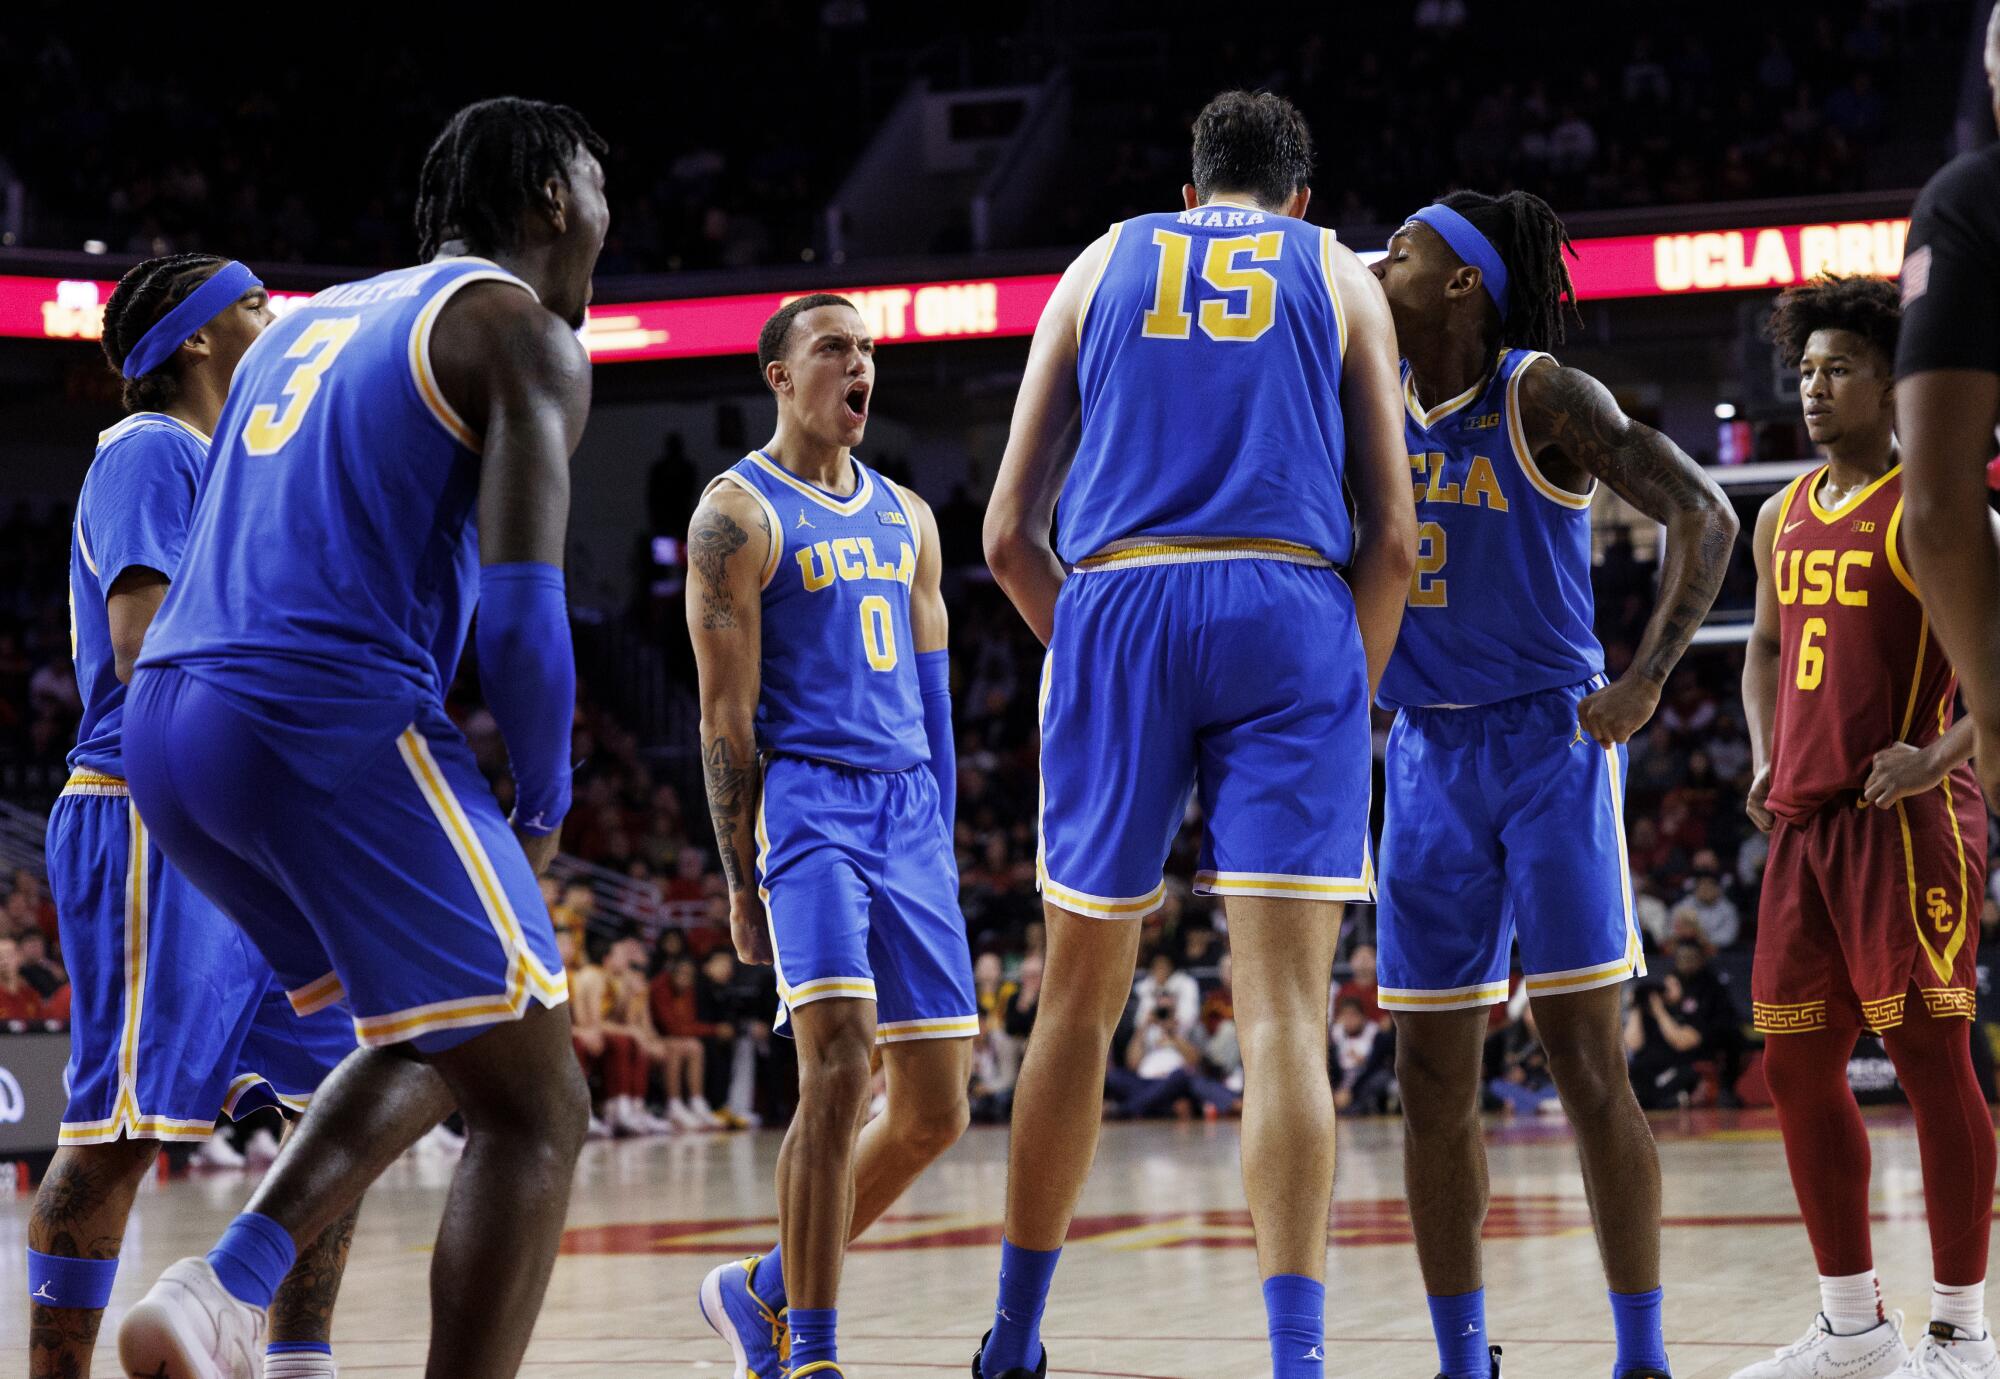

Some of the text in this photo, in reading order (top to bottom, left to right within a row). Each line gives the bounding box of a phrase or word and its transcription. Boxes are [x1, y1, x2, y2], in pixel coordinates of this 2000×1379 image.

[1176, 211, 1265, 227] MARA
[1141, 227, 1285, 342] 15
[1654, 228, 1795, 291] UCLA
[241, 313, 361, 457] 3
[795, 536, 918, 595] UCLA
[1408, 521, 1448, 608] 2
[1775, 549, 1874, 608] USC
[859, 595, 898, 672] 0
[1796, 617, 1827, 691] 6
